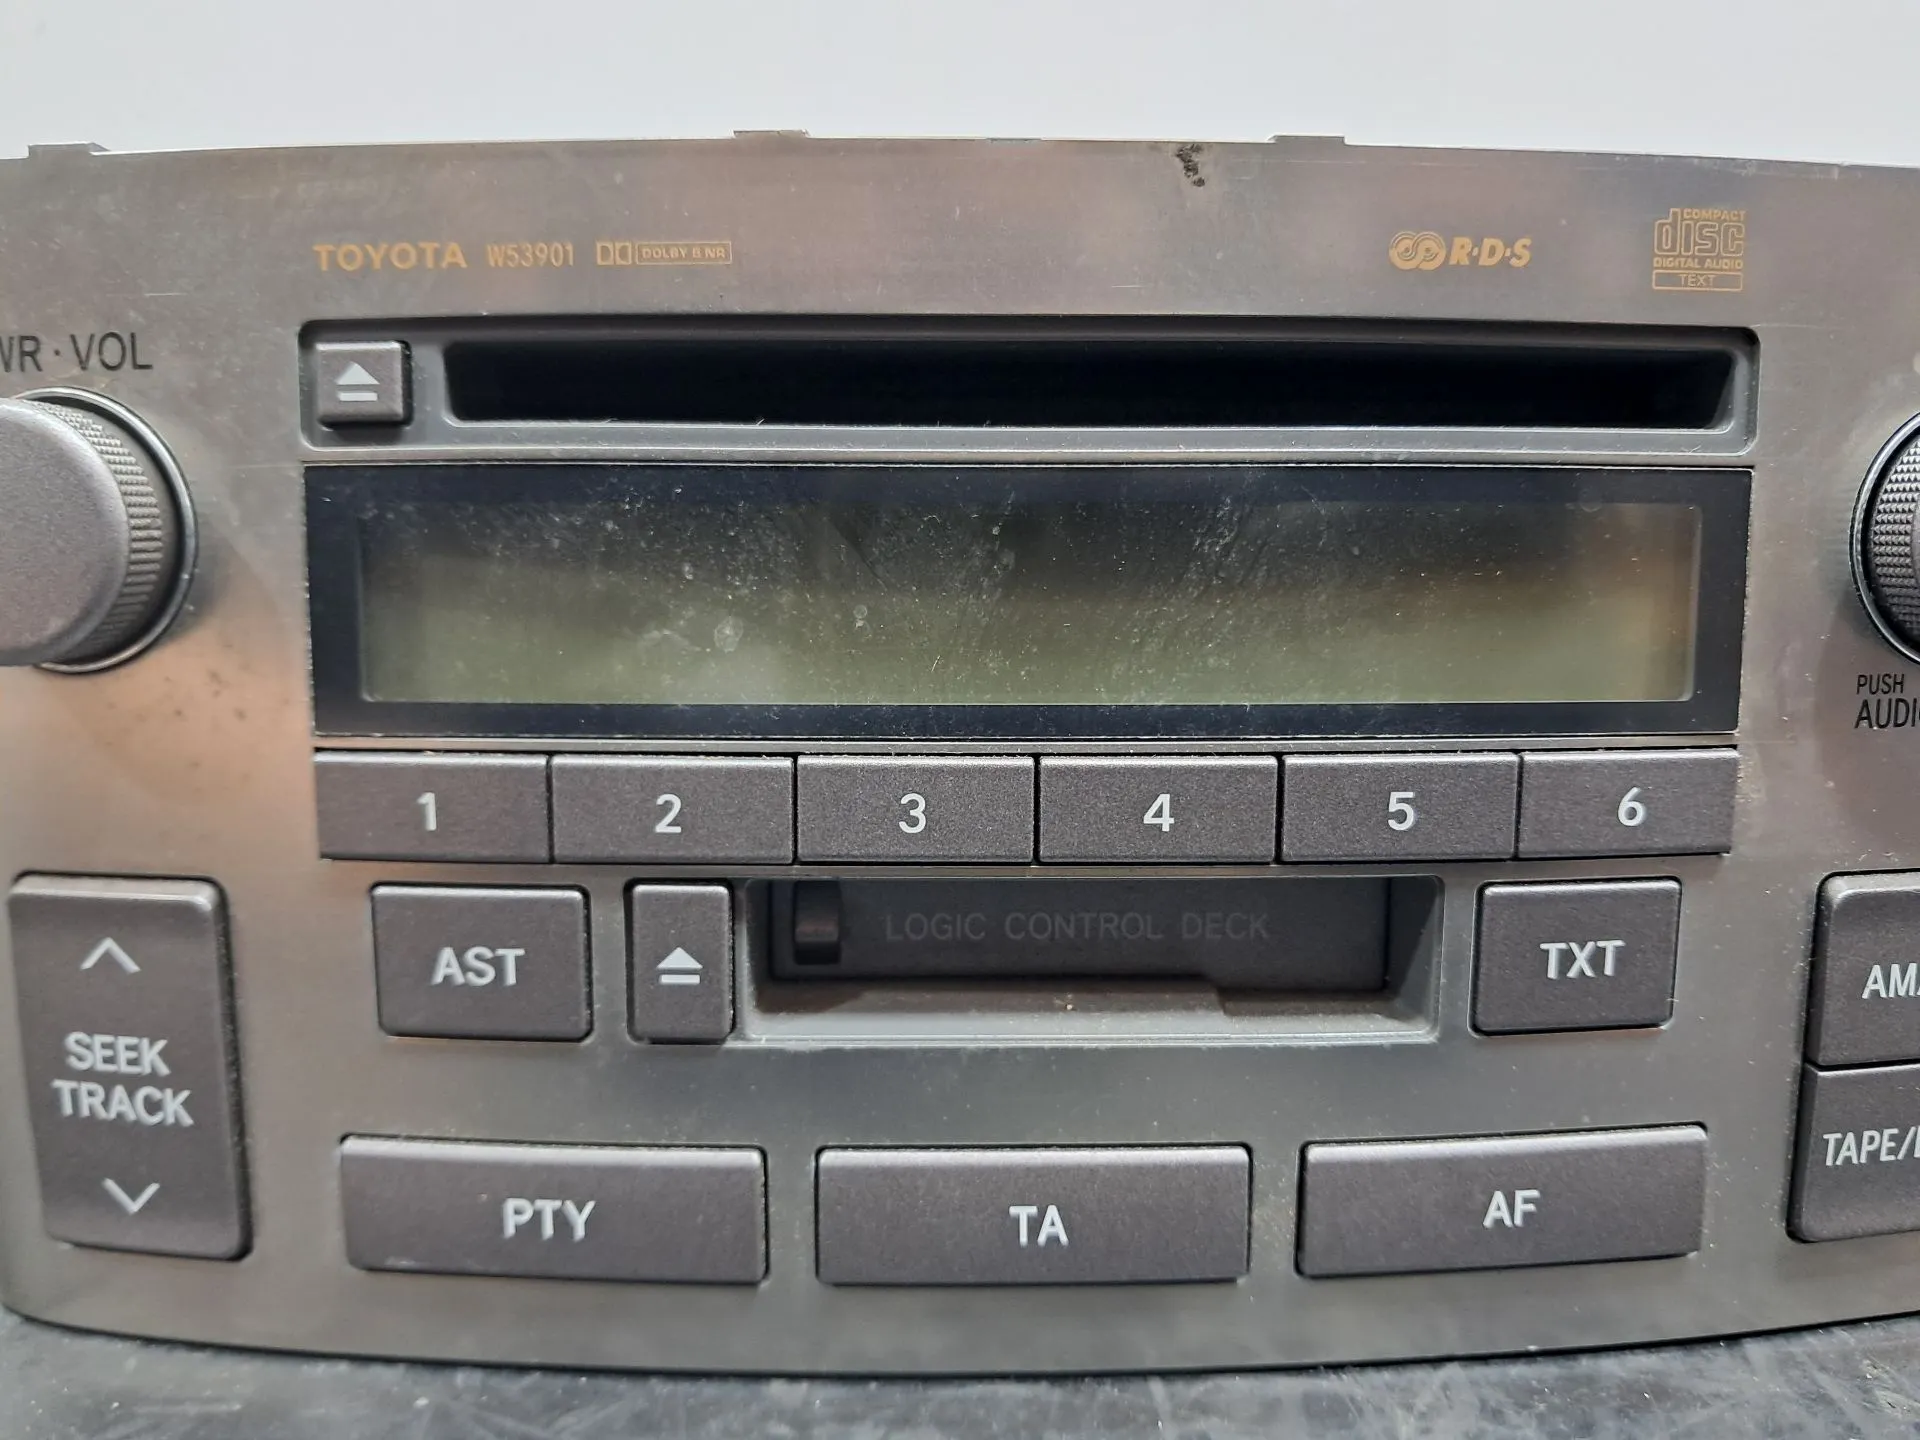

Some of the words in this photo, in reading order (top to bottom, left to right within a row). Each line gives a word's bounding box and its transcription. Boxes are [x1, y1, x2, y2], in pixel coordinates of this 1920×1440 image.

[1683, 208, 1746, 220] COMPACT
[313, 242, 468, 271] TOYOTA
[488, 242, 574, 267] W53901
[642, 247, 687, 259] DOLBY
[704, 248, 726, 259] NR
[1653, 257, 1701, 268] DIGITAL
[1704, 258, 1744, 269] AUDIO
[1678, 273, 1716, 287] TEXT
[70, 332, 153, 371] VOL
[1856, 673, 1905, 695] PUSH
[1854, 698, 1920, 729] AUDI
[417, 792, 438, 832] 1
[654, 793, 683, 834] 2
[898, 793, 928, 834] 3
[1143, 793, 1176, 832] 4
[1387, 791, 1417, 832] 5
[1616, 786, 1647, 827] 6
[885, 912, 986, 942] LOGIC
[1004, 911, 1164, 940] CONTROL
[1181, 912, 1271, 940] DECK
[431, 946, 525, 986] AST
[1540, 940, 1626, 980] TXT
[1862, 962, 1920, 999] AM
[64, 1031, 171, 1077] SEEK
[52, 1079, 194, 1127] TRACK
[502, 1198, 596, 1242] PTY
[1008, 1204, 1069, 1246] TA
[1482, 1189, 1541, 1228] AF
